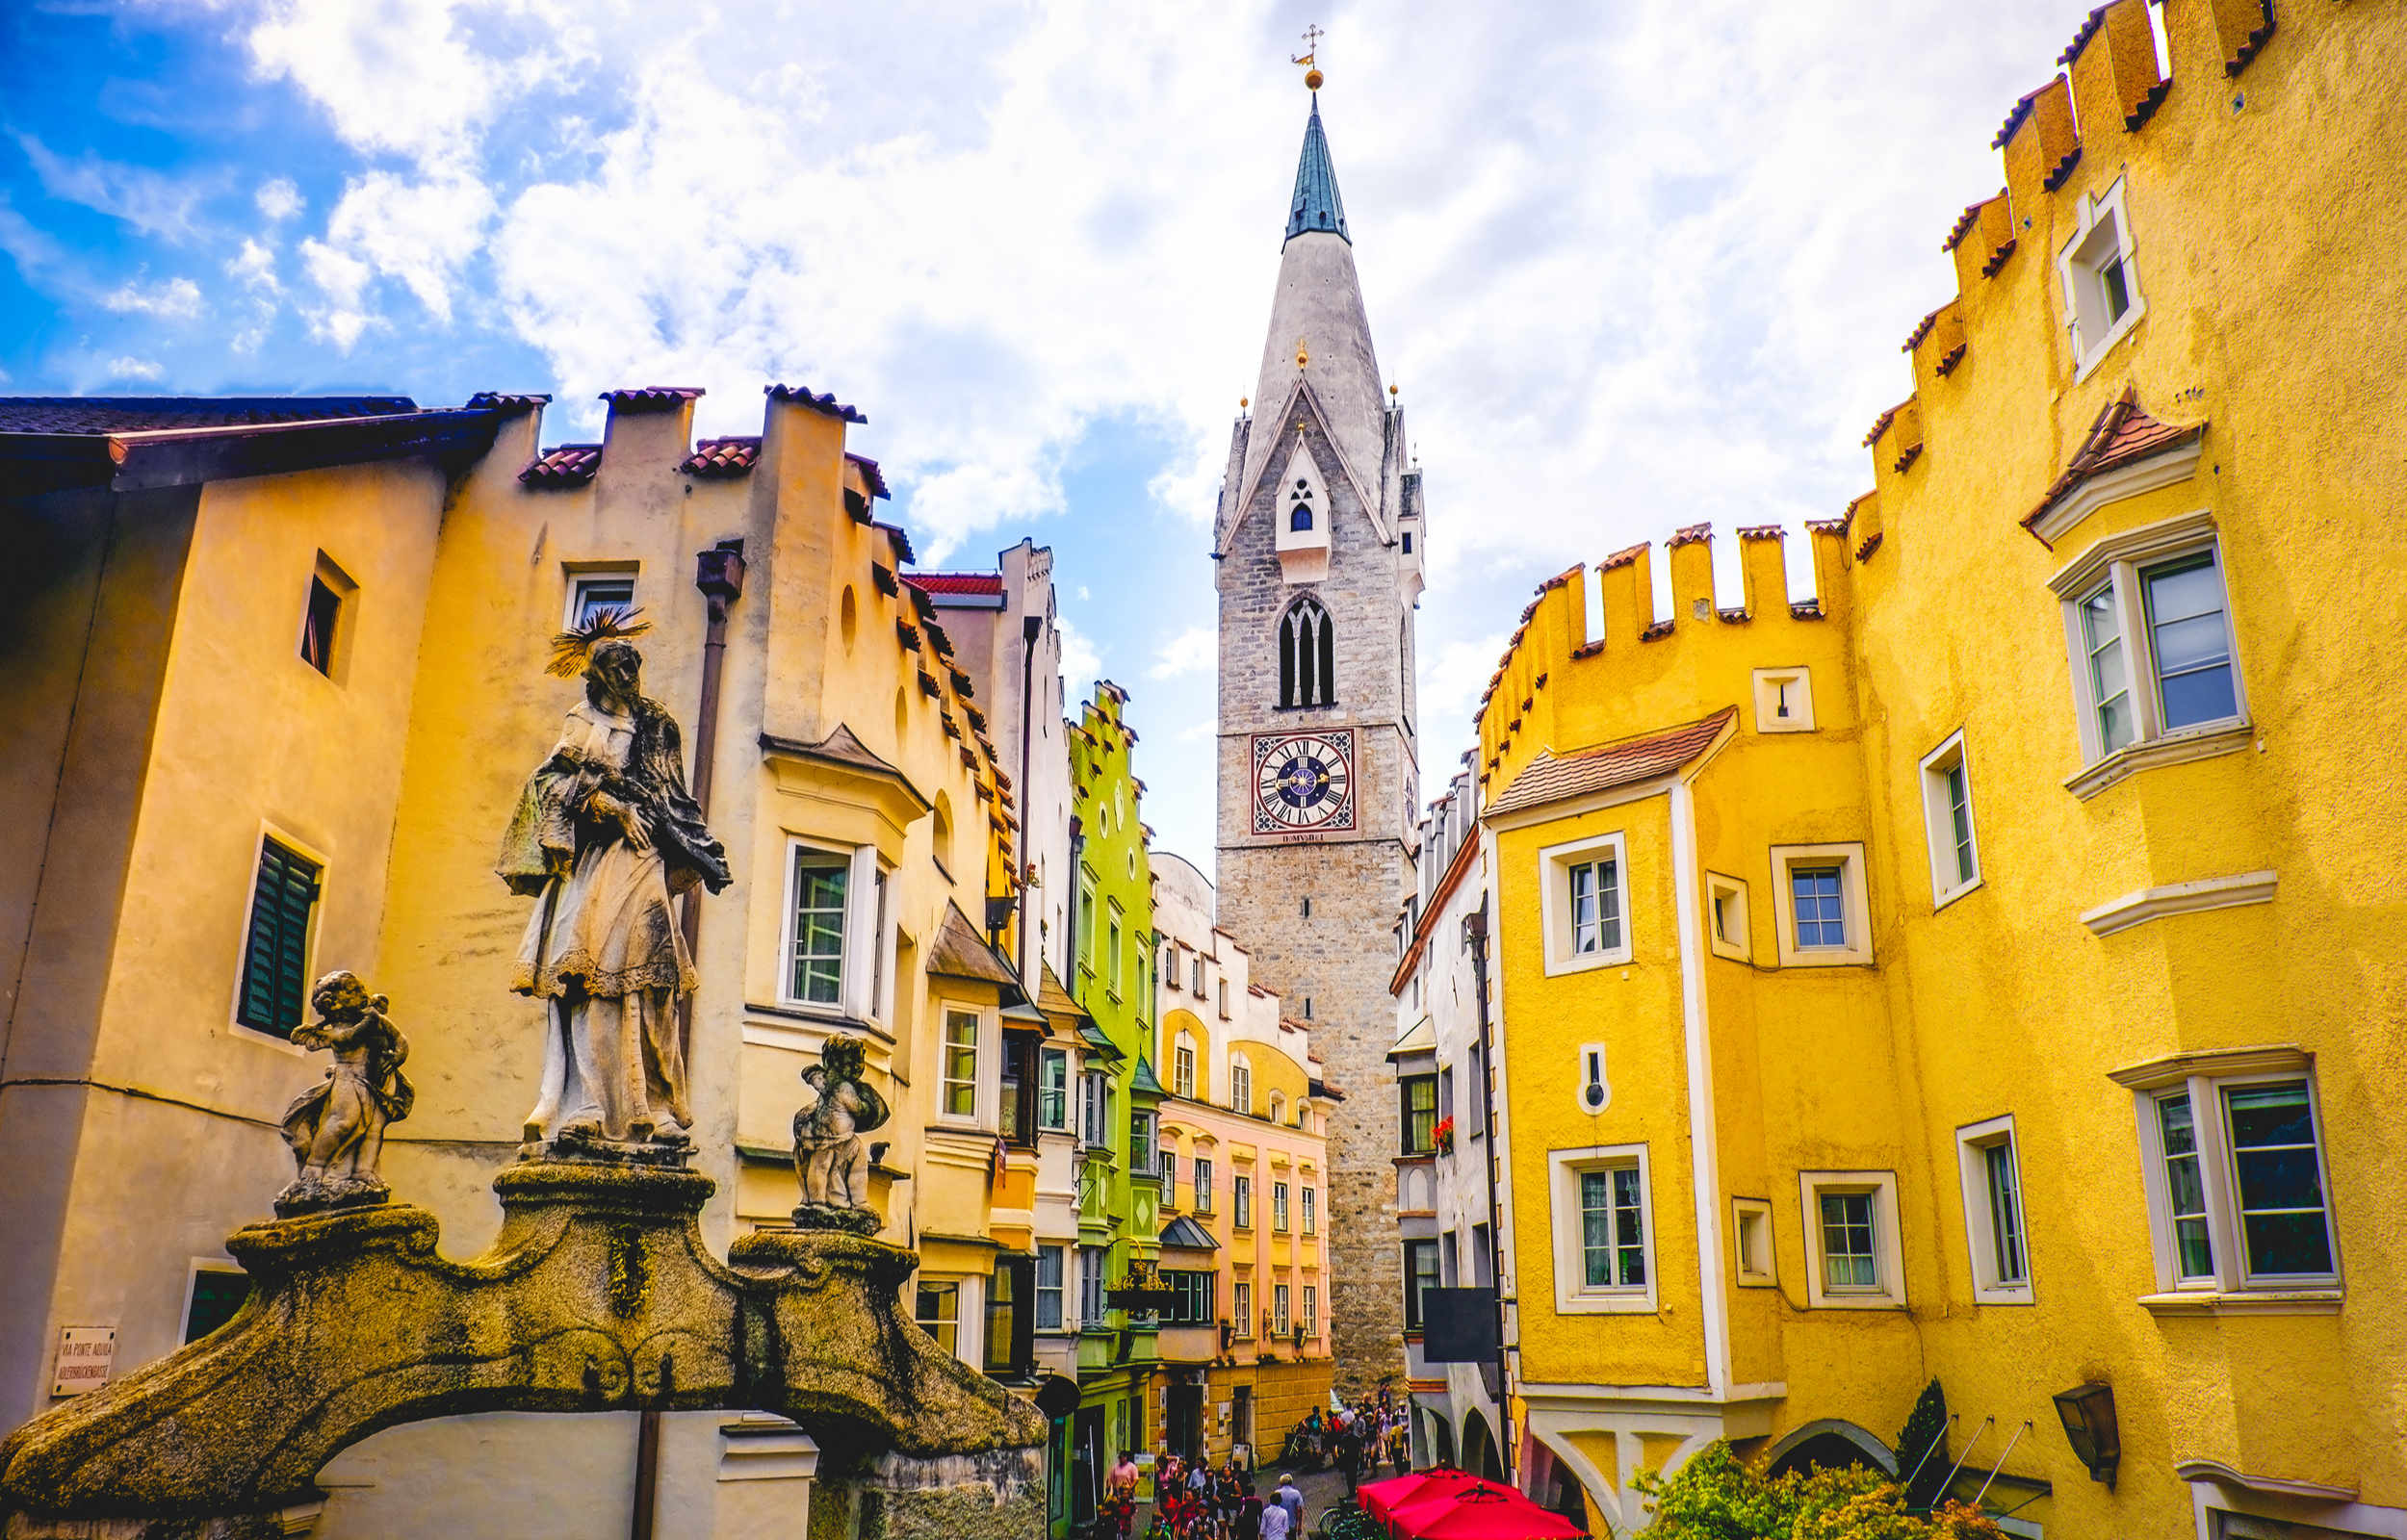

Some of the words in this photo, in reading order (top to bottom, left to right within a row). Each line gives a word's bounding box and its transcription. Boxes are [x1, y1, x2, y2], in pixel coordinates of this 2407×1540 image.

[62, 1343, 72, 1356] VIA
[73, 1343, 92, 1356] PONTE
[92, 1343, 112, 1356] AQUILA
